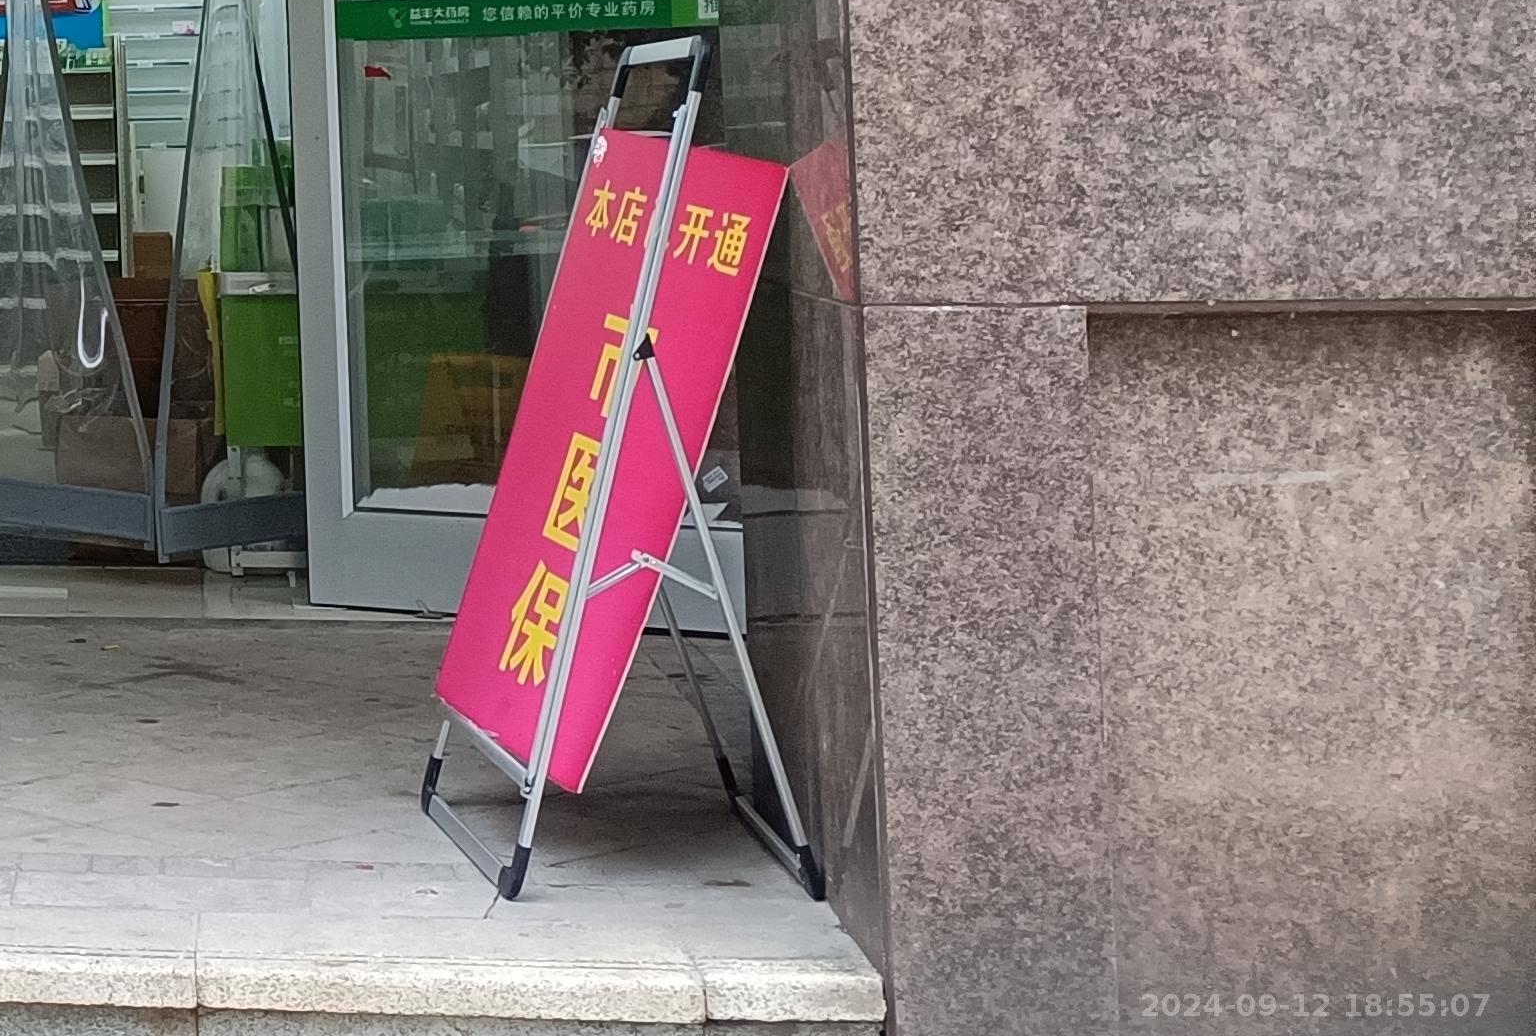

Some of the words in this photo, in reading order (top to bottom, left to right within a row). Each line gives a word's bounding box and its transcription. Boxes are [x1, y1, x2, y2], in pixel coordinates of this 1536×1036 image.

[408, 6, 471, 20] 益丰大药房
[482, 0, 656, 23] 您信赖的平价专业药房
[584, 179, 752, 277] 本店开通
